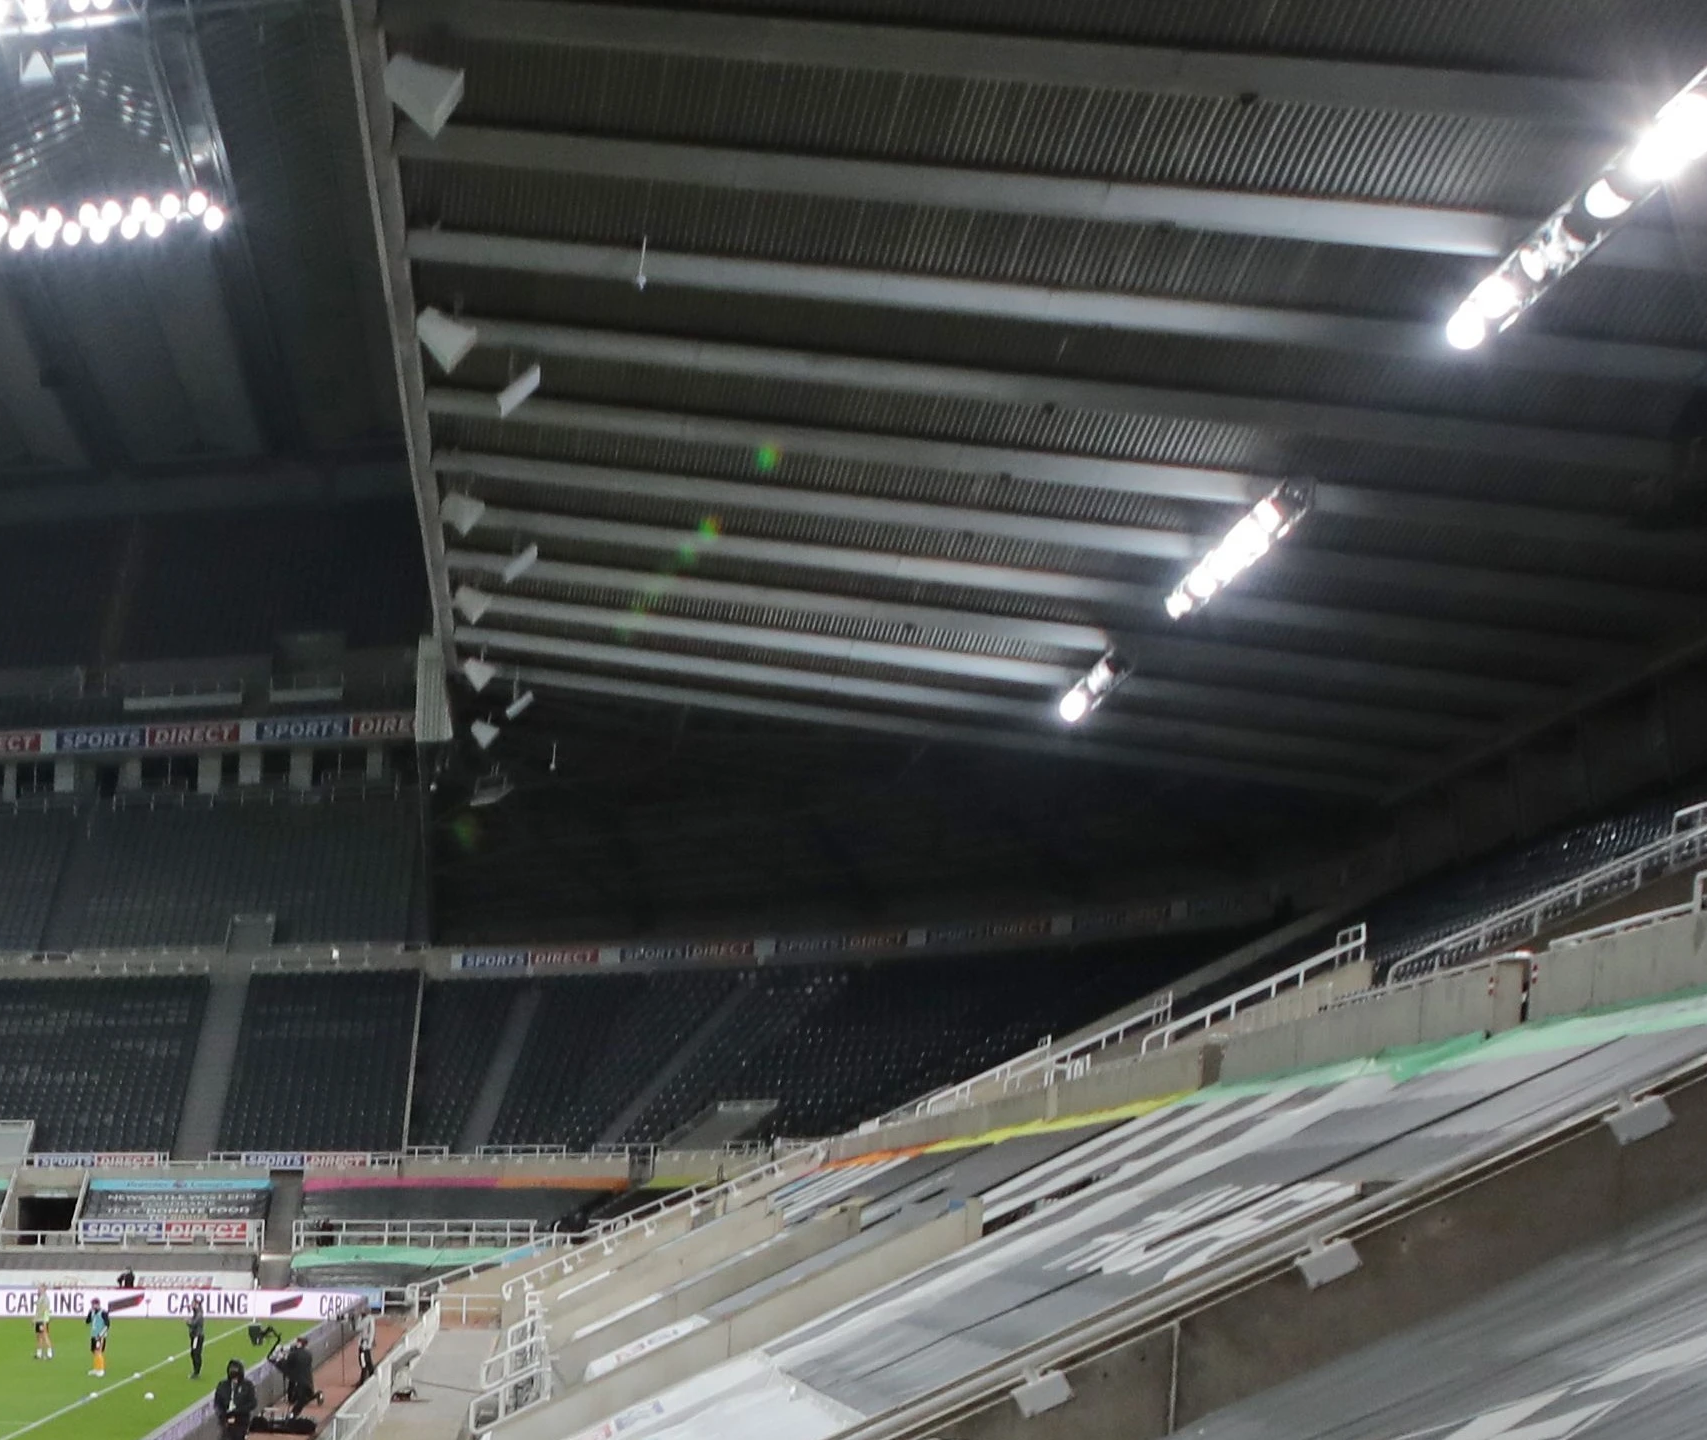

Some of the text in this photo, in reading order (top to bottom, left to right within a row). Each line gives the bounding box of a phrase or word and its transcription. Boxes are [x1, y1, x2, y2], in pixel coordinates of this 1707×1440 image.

[261, 716, 415, 737] SPORTS DIRE
[63, 726, 231, 749] SPORTS DIRECT
[463, 950, 594, 968] SPORTS DIRECT
[691, 943, 751, 959] DIRECT
[40, 1156, 153, 1167] SPORTS DIRECT
[248, 1155, 365, 1167] SPORTS DIRECT
[87, 1223, 243, 1237] SPORTS DIRECT
